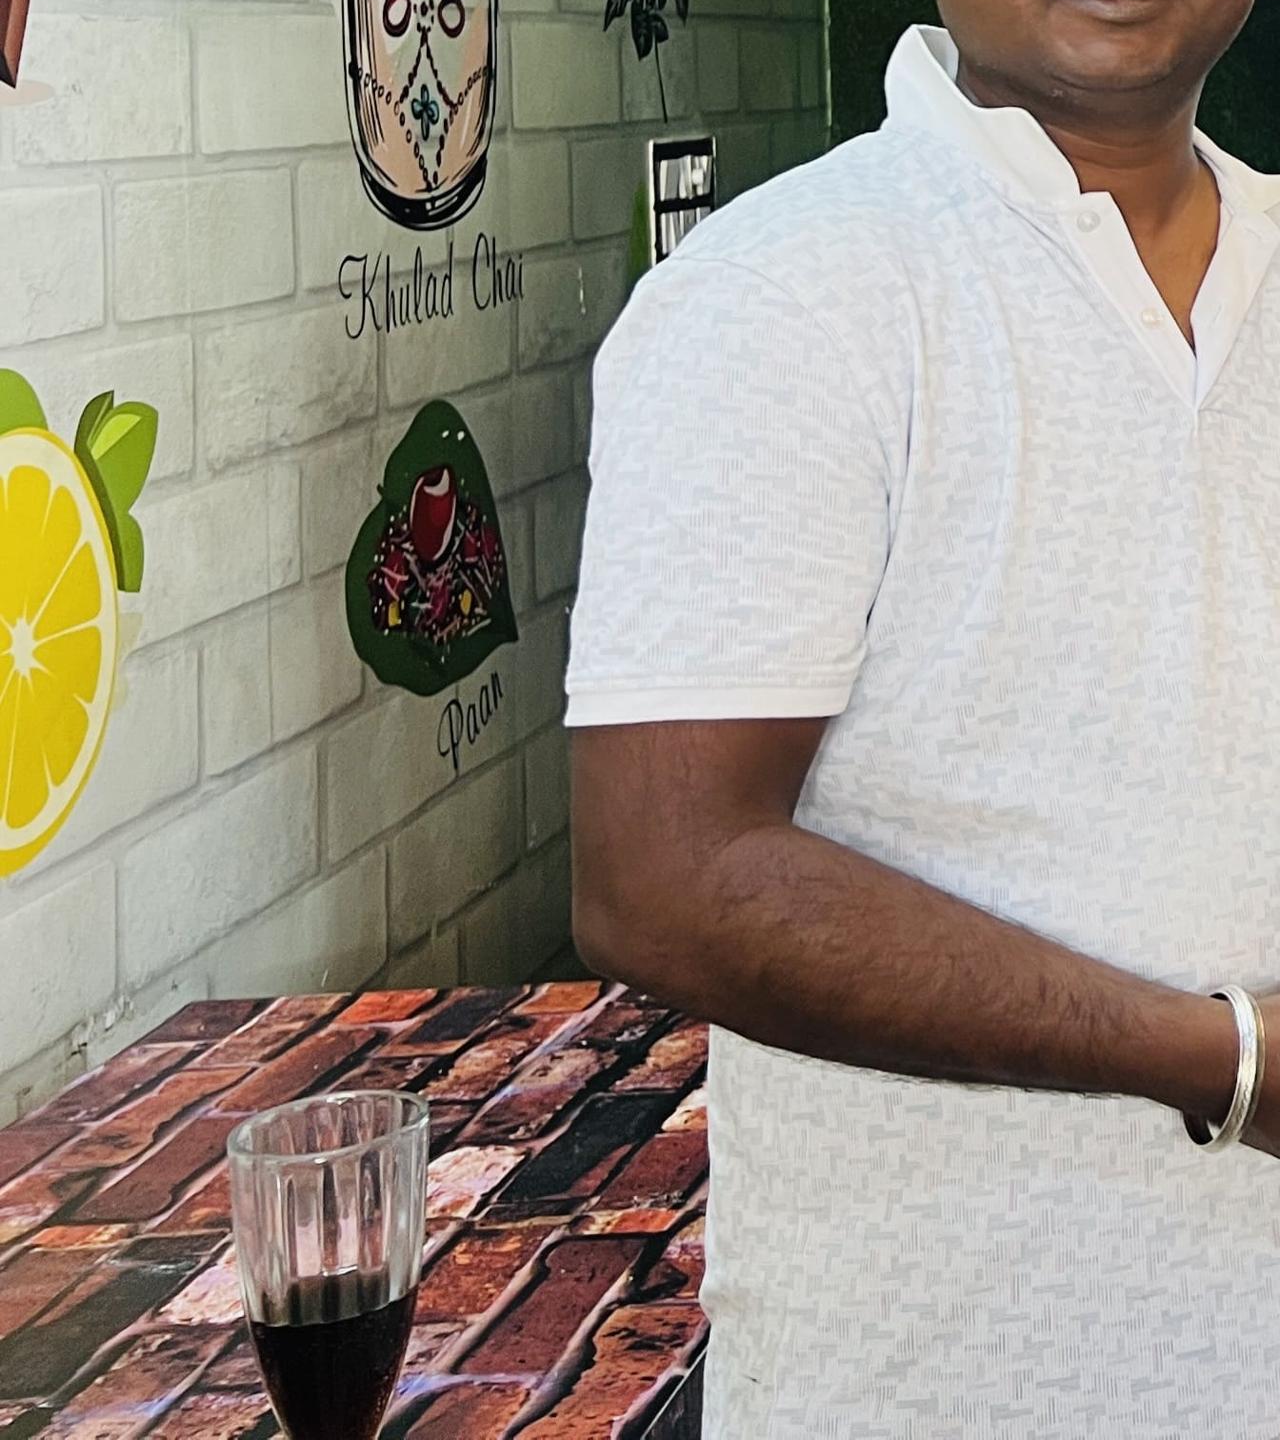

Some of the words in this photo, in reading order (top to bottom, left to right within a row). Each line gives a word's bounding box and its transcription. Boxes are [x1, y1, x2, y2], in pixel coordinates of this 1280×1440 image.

[338, 241, 454, 339] Khulad
[473, 232, 525, 311] Chai
[437, 670, 503, 770] Paan
